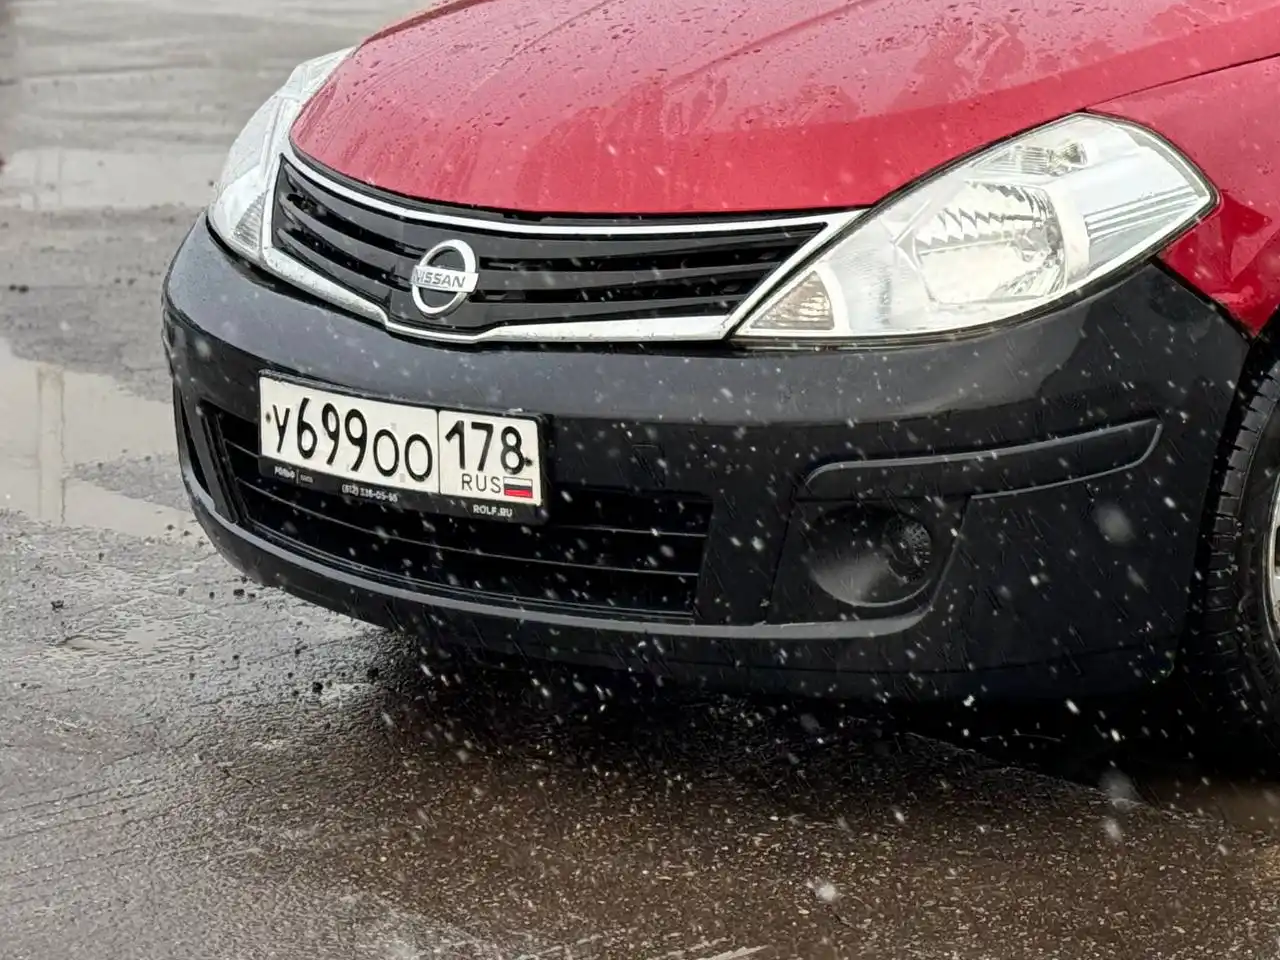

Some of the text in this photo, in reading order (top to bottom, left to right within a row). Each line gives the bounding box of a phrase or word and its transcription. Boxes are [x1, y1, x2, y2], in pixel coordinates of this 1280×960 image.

[416, 270, 466, 288] NISSAN
[461, 473, 501, 494] RUS
[473, 504, 513, 517] ROLF.RU
